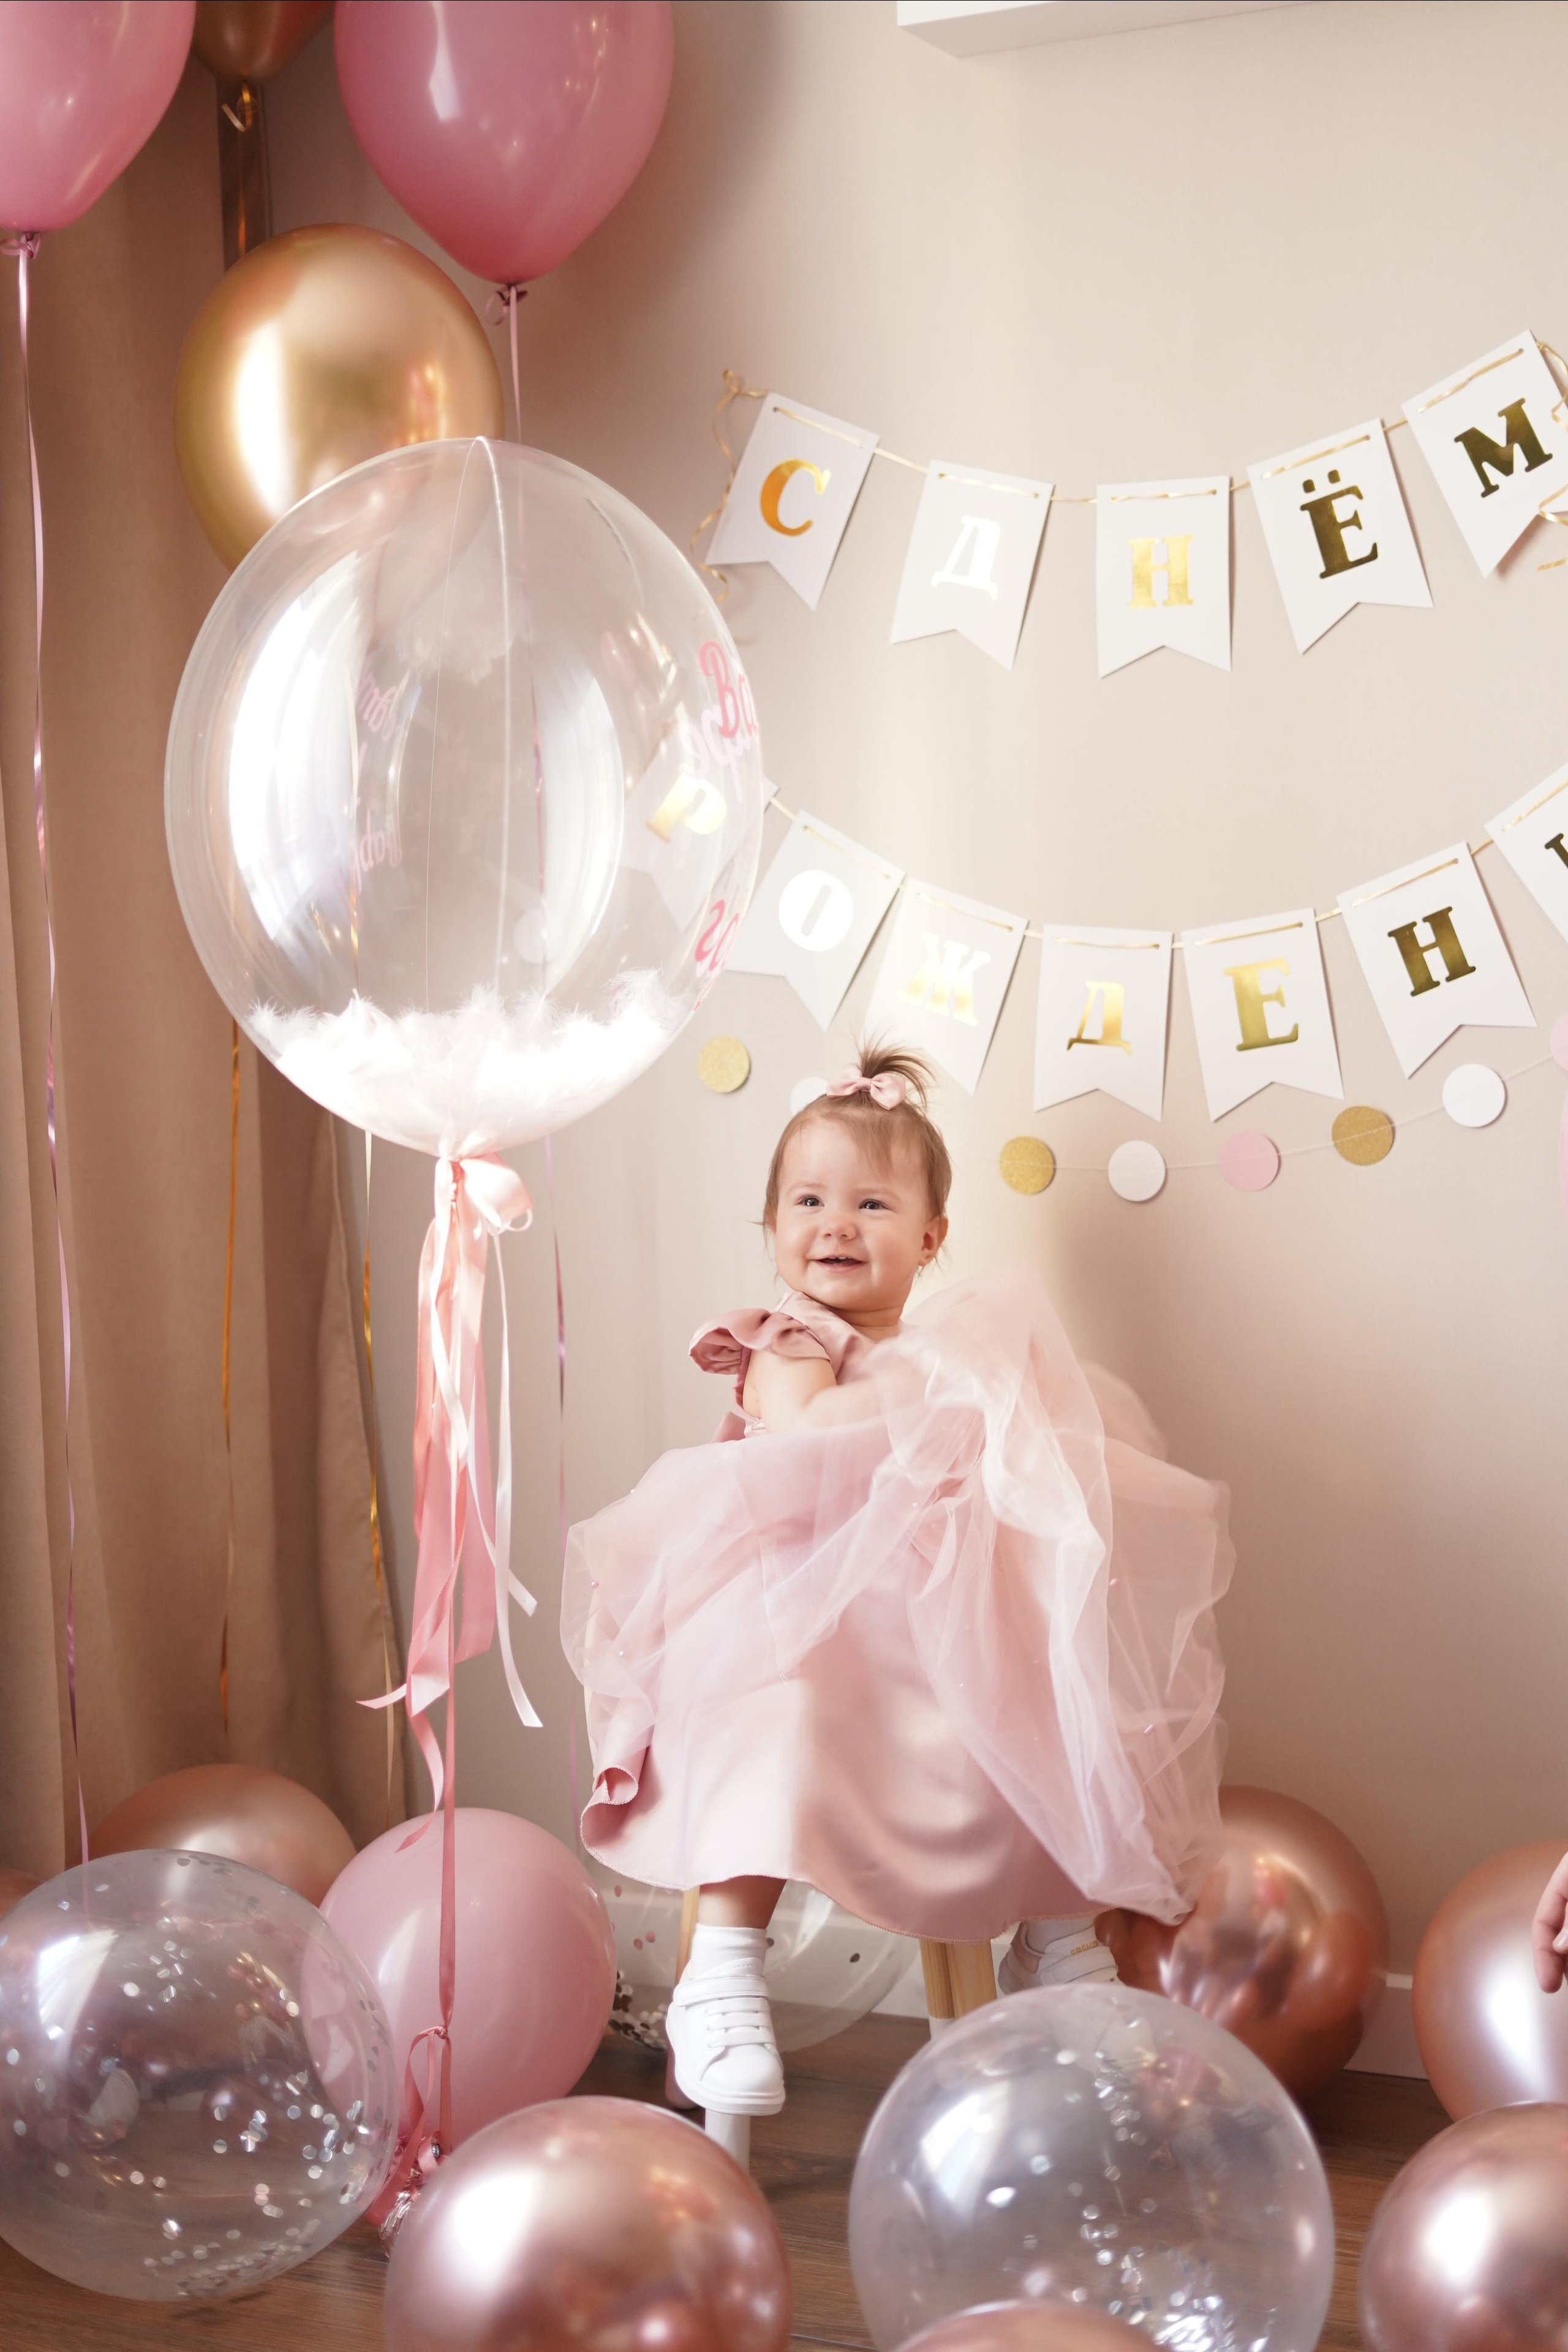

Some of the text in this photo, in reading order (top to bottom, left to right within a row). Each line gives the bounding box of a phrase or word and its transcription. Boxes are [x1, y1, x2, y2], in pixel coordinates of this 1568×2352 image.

[759, 398, 1553, 609] С ДНЁМ
[645, 774, 1568, 1055] РОЖДЕН
